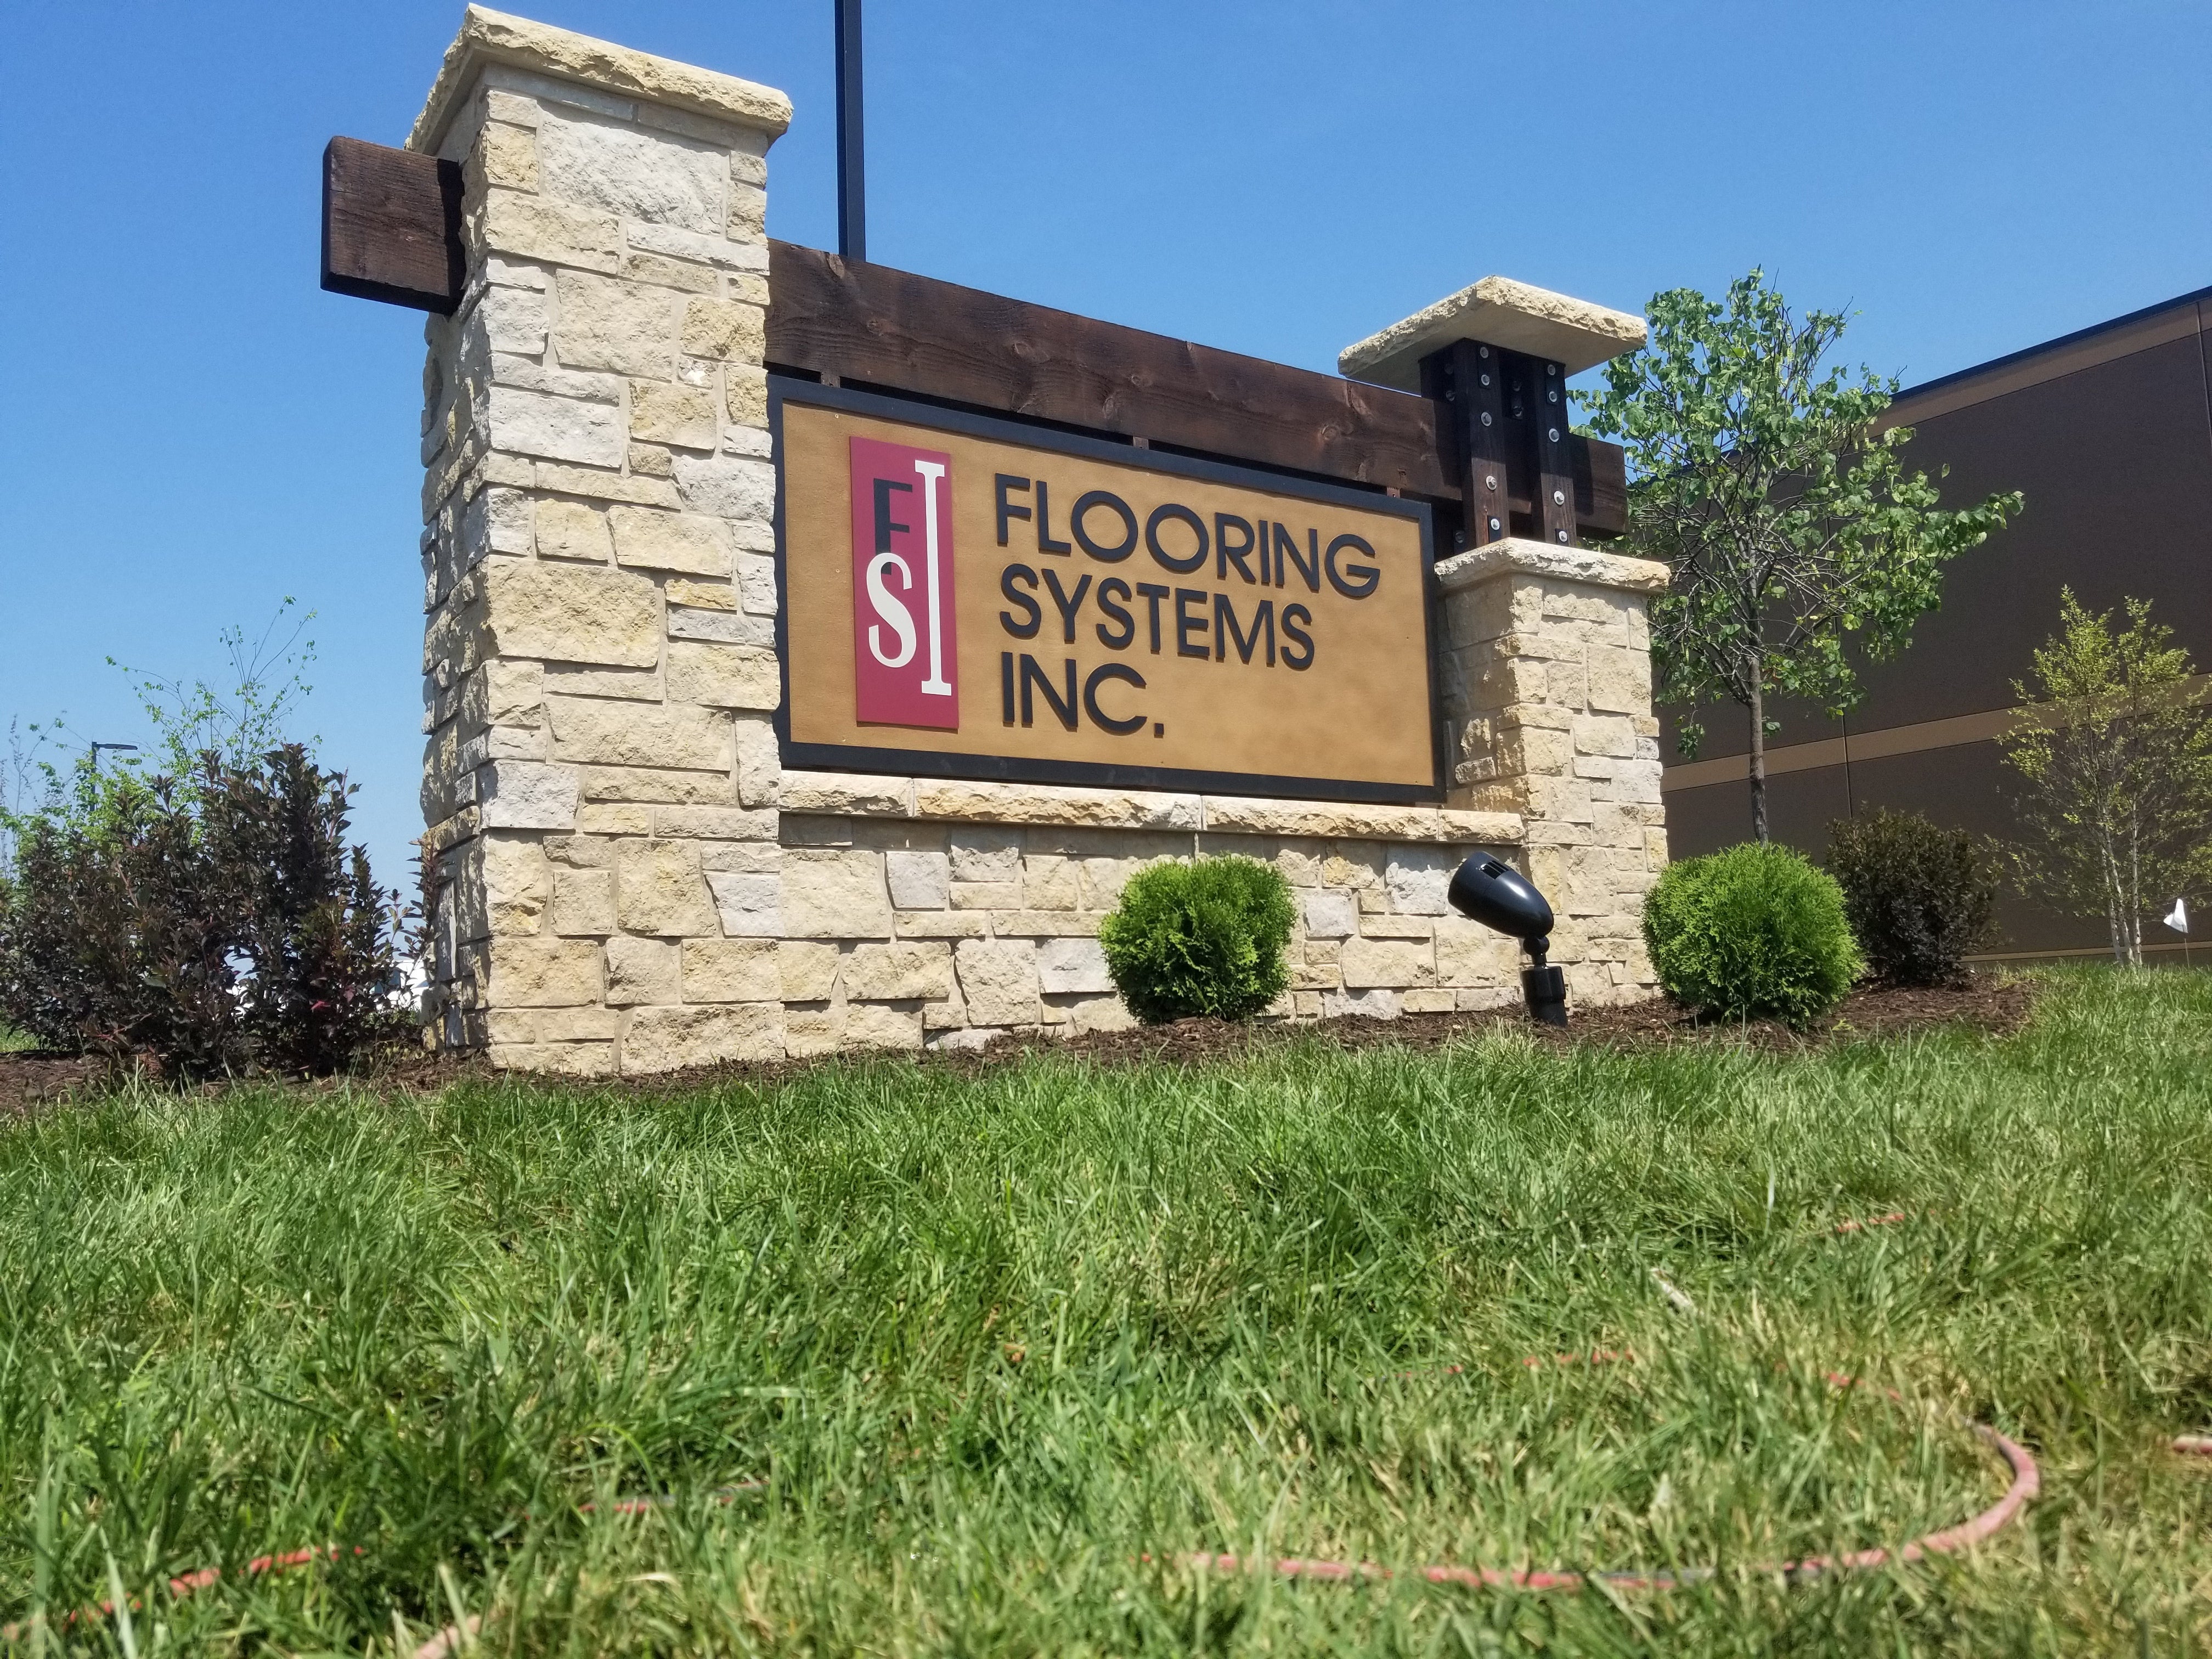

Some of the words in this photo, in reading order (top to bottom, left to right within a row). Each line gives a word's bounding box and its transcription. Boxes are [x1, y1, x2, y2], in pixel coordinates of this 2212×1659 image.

[994, 473, 1381, 599] FLOORING
[998, 563, 1315, 670] SYSTEMS
[1001, 651, 1165, 737] INC.
